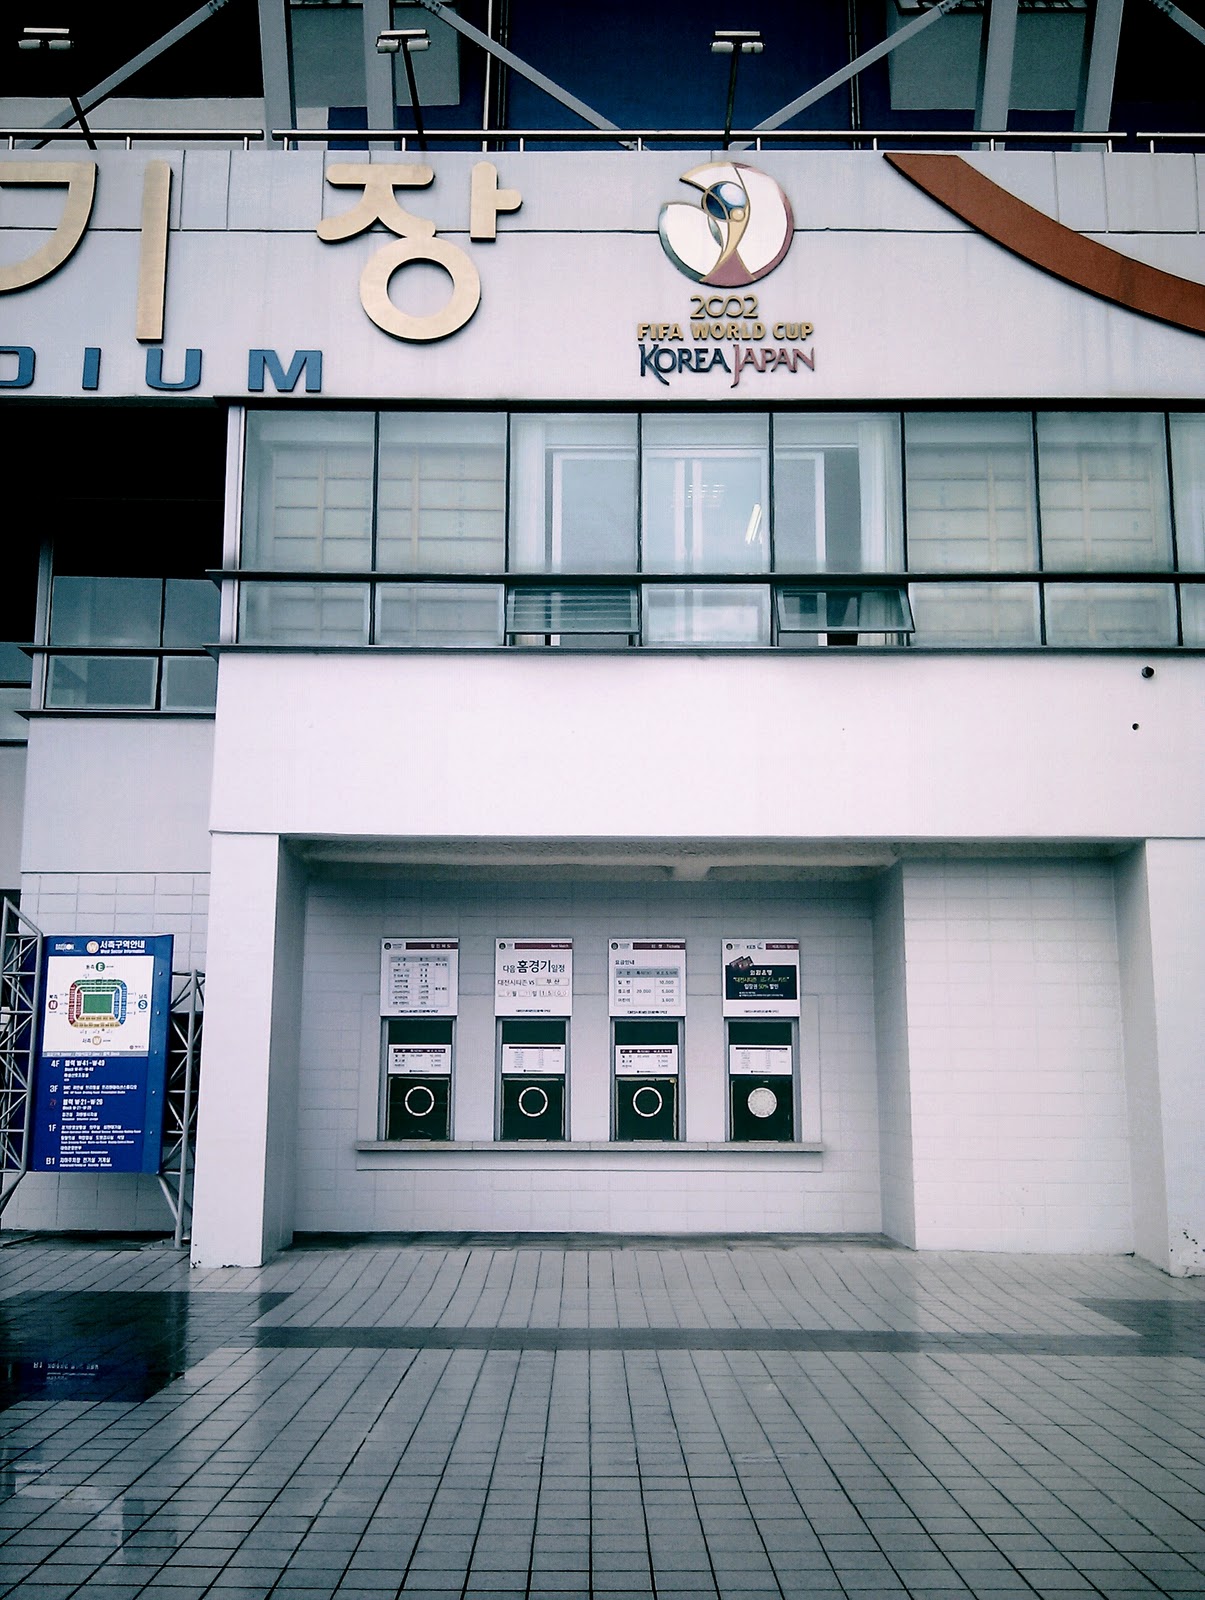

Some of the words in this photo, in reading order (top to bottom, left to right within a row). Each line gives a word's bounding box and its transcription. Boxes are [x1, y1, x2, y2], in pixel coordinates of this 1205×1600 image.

[690, 294, 758, 319] 2002
[637, 322, 684, 341] FIFA
[690, 322, 767, 341] WORLD
[772, 322, 815, 341] CUP
[638, 344, 732, 386] KOREA
[731, 344, 815, 389] JAPAN
[49, 1085, 58, 1093] 3F
